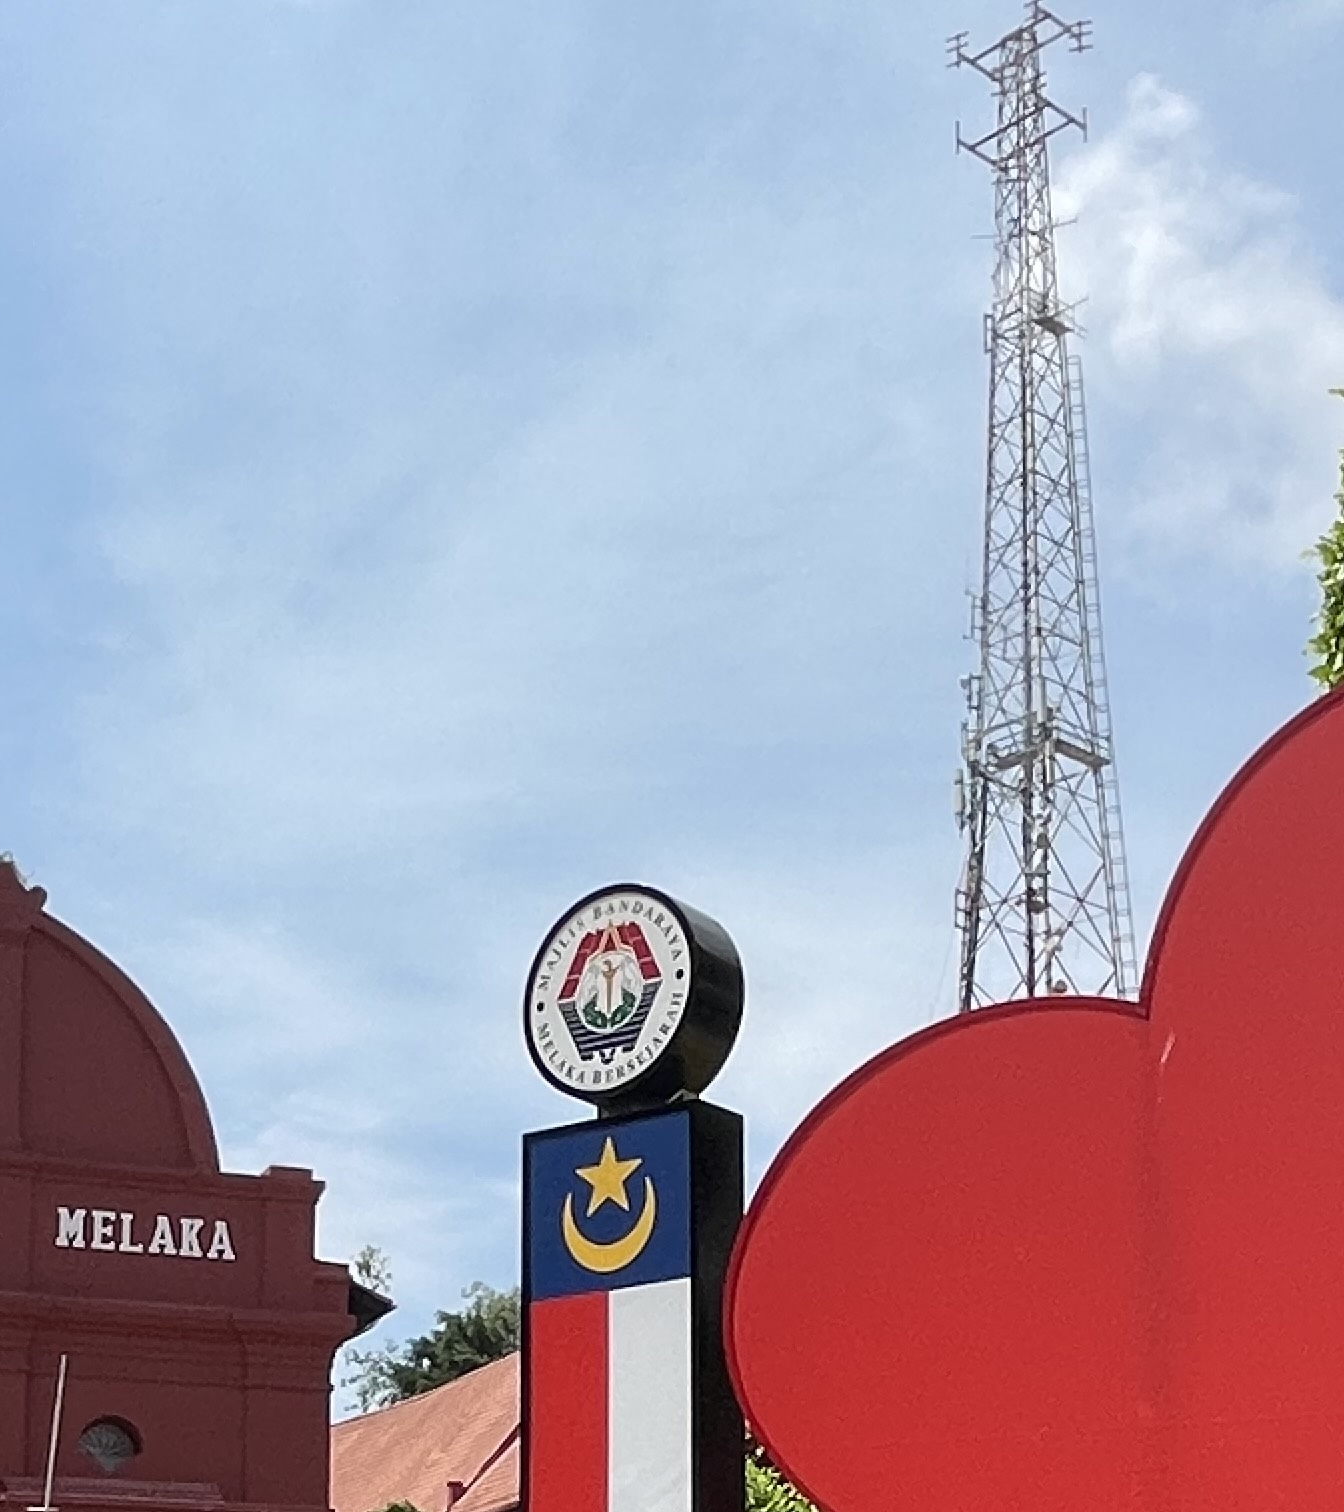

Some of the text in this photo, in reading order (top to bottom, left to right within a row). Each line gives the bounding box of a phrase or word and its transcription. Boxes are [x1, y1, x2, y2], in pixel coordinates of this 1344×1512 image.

[538, 900, 683, 991] MAJLIS BANDARAYA
[536, 992, 684, 1084] MELAKA BERSEJARAH
[55, 1206, 237, 1261] MELAKA
